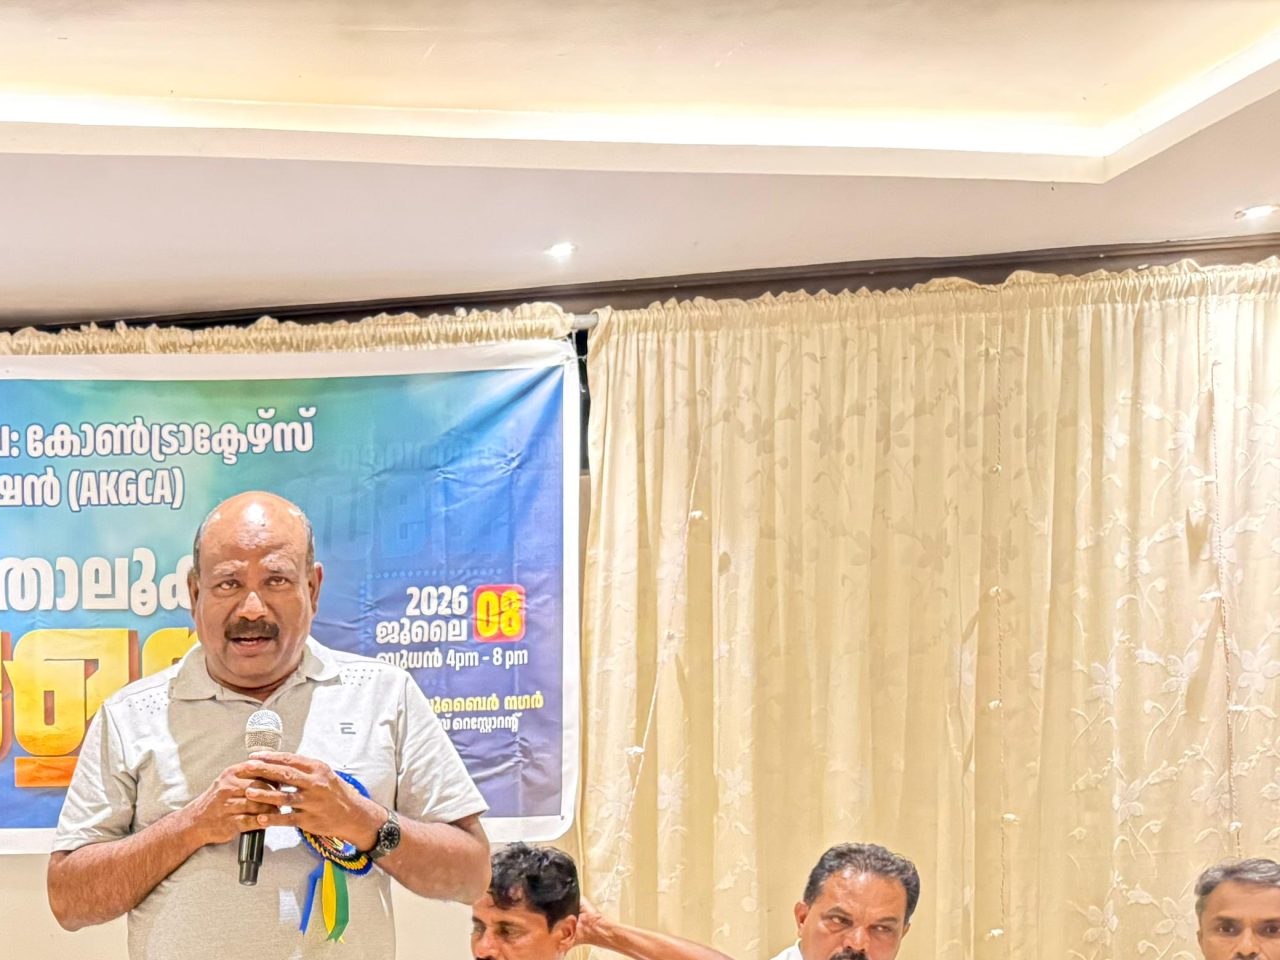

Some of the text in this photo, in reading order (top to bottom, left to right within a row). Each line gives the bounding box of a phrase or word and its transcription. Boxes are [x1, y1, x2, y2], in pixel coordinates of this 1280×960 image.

[68, 467, 184, 511] (AKGCA)
[405, 585, 468, 616] 2026
[476, 589, 523, 638] 08
[376, 617, 468, 645] ജൂലൈ
[446, 648, 479, 671] 4pm
[493, 648, 503, 666] 8
[505, 648, 528, 669] pm
[430, 691, 544, 714] ുബൈർ നഗർ
